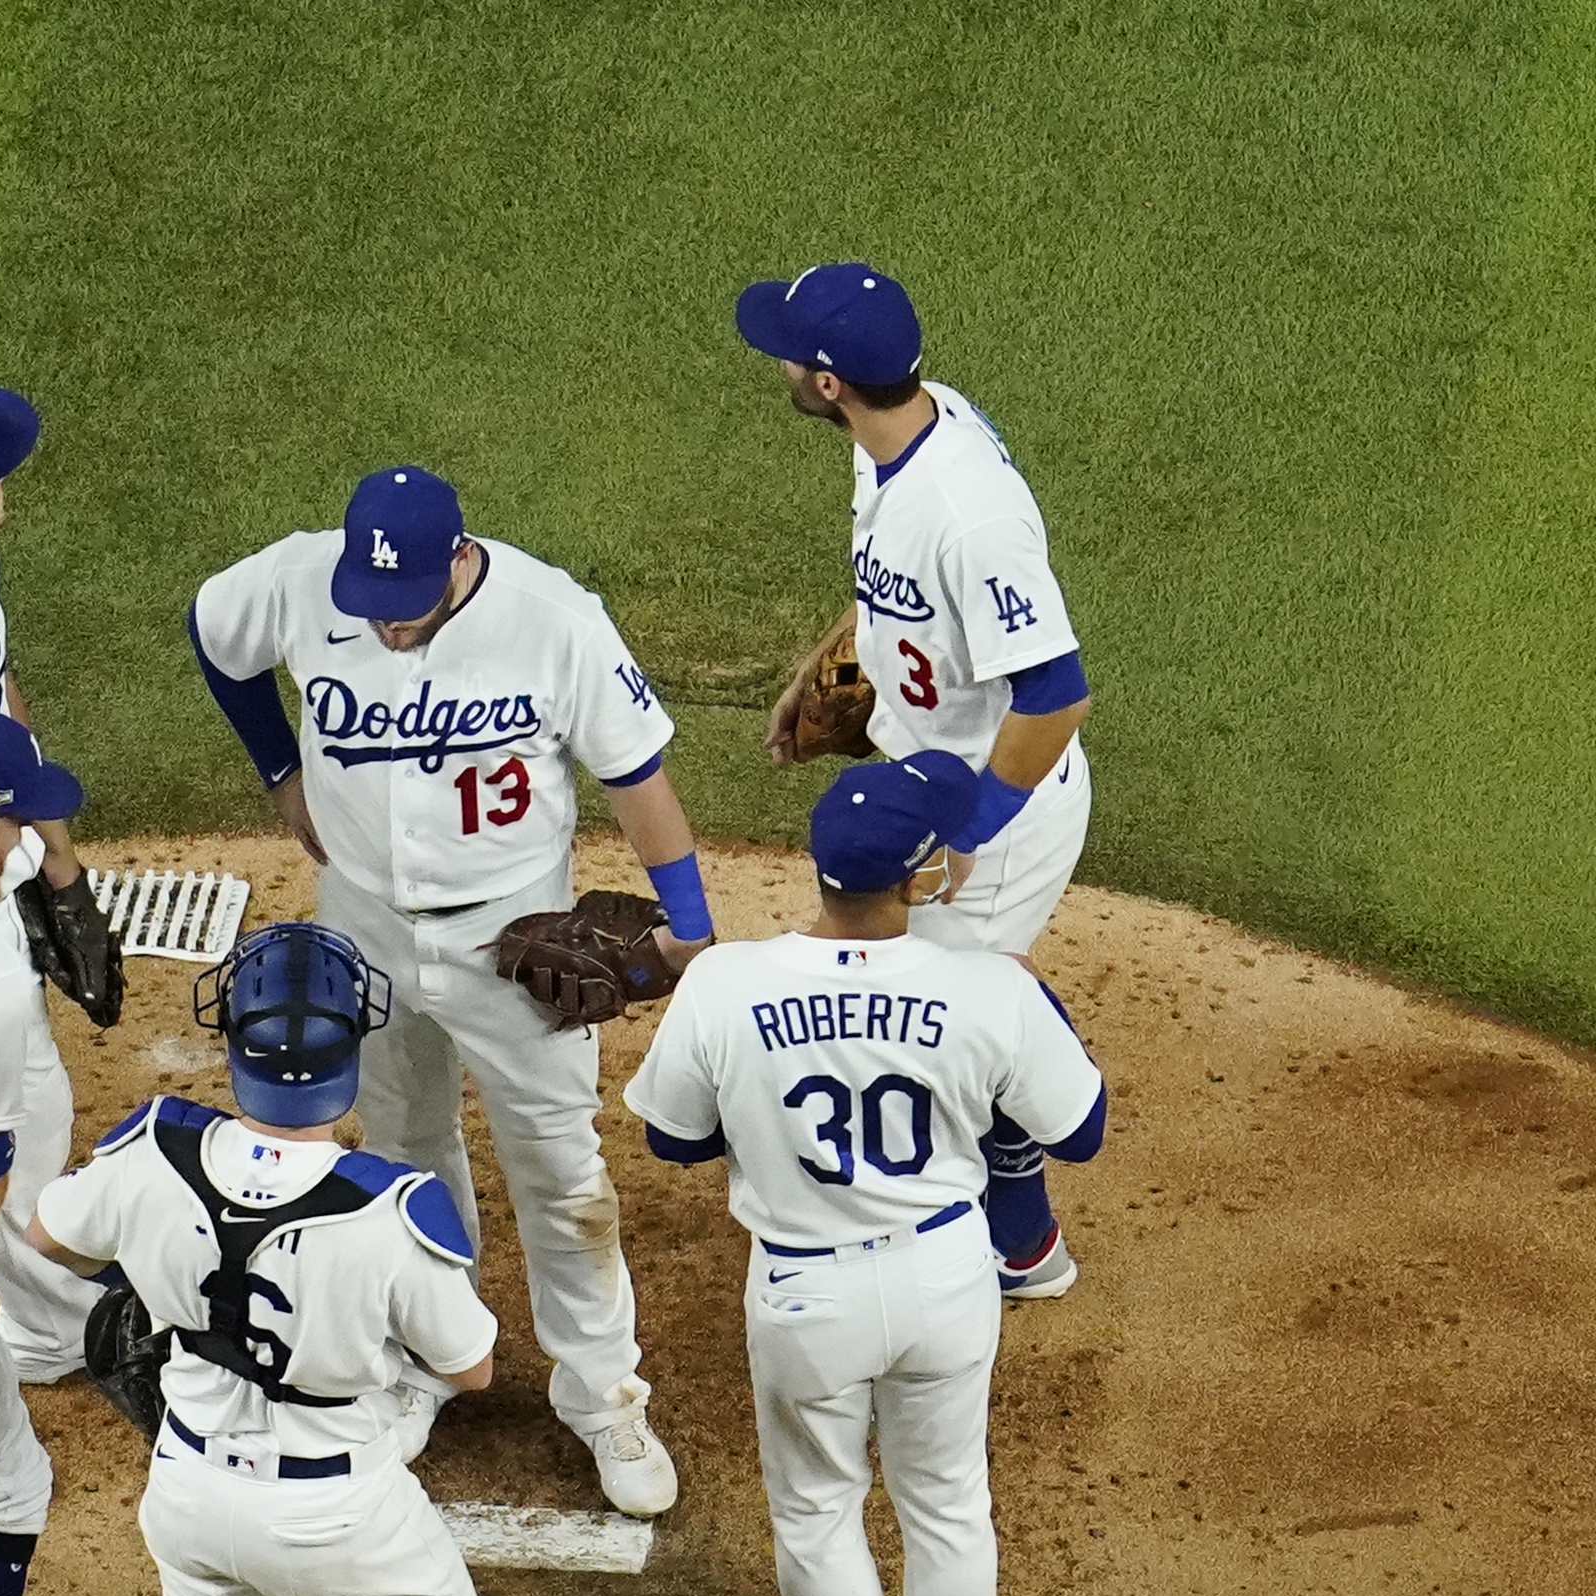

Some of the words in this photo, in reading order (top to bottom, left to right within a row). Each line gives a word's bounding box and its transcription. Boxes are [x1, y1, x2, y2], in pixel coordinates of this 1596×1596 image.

[370, 528, 399, 569] LA
[853, 534, 935, 628] dgers
[984, 576, 1038, 634] LA
[614, 663, 654, 712] LA
[898, 638, 939, 711] 3
[306, 676, 542, 775] Dodgers
[454, 756, 532, 836] 13
[752, 993, 949, 1052] ROBERTS
[782, 1073, 935, 1187] 30
